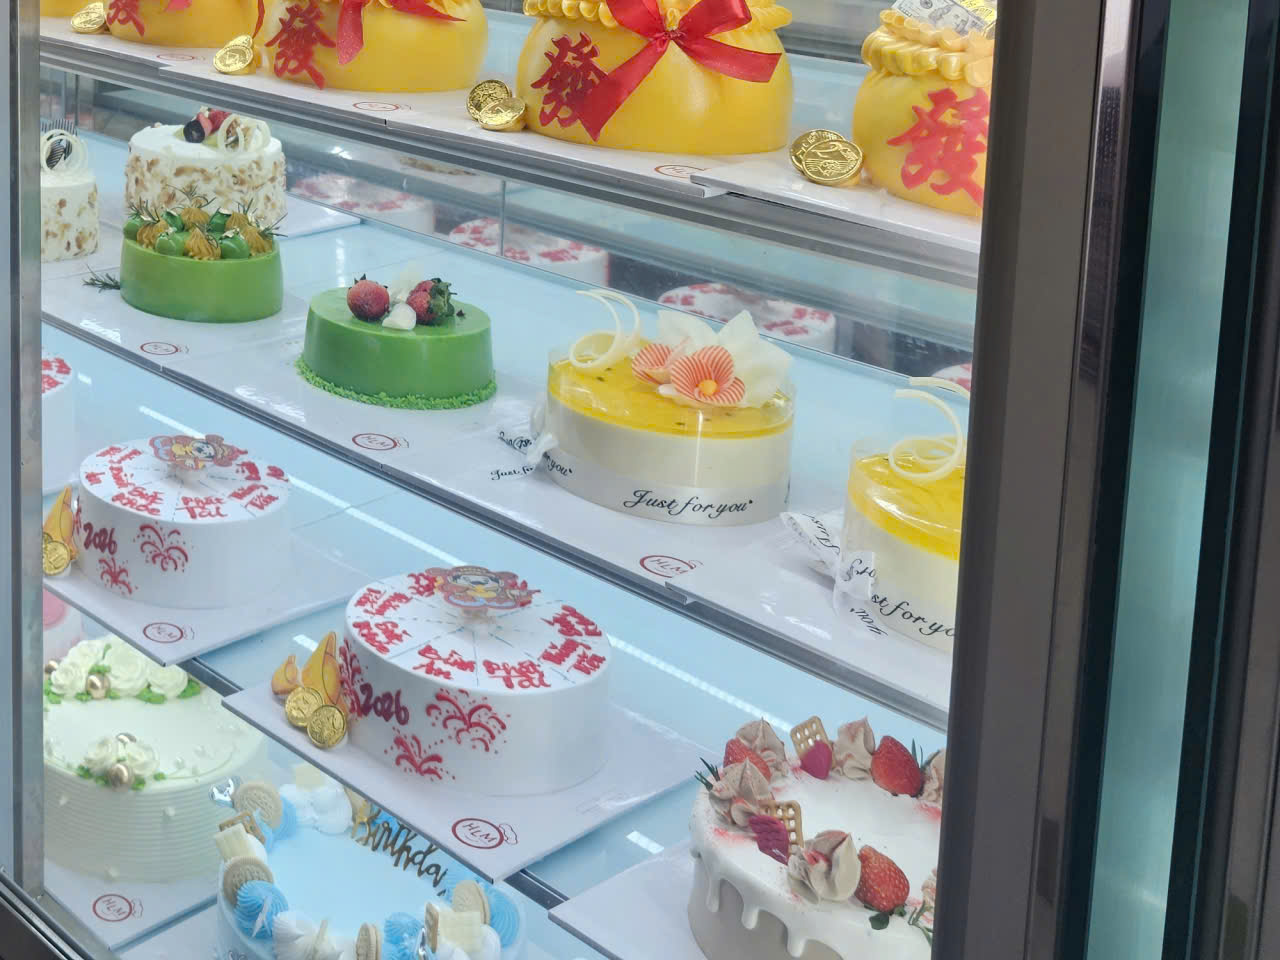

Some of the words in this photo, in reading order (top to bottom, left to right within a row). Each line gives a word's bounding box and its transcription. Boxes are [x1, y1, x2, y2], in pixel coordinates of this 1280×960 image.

[623, 490, 680, 510] Just
[673, 495, 715, 516] for
[708, 499, 749, 519] you
[83, 522, 118, 556] 2026
[359, 682, 410, 726] 2026
[461, 822, 498, 843] HLM
